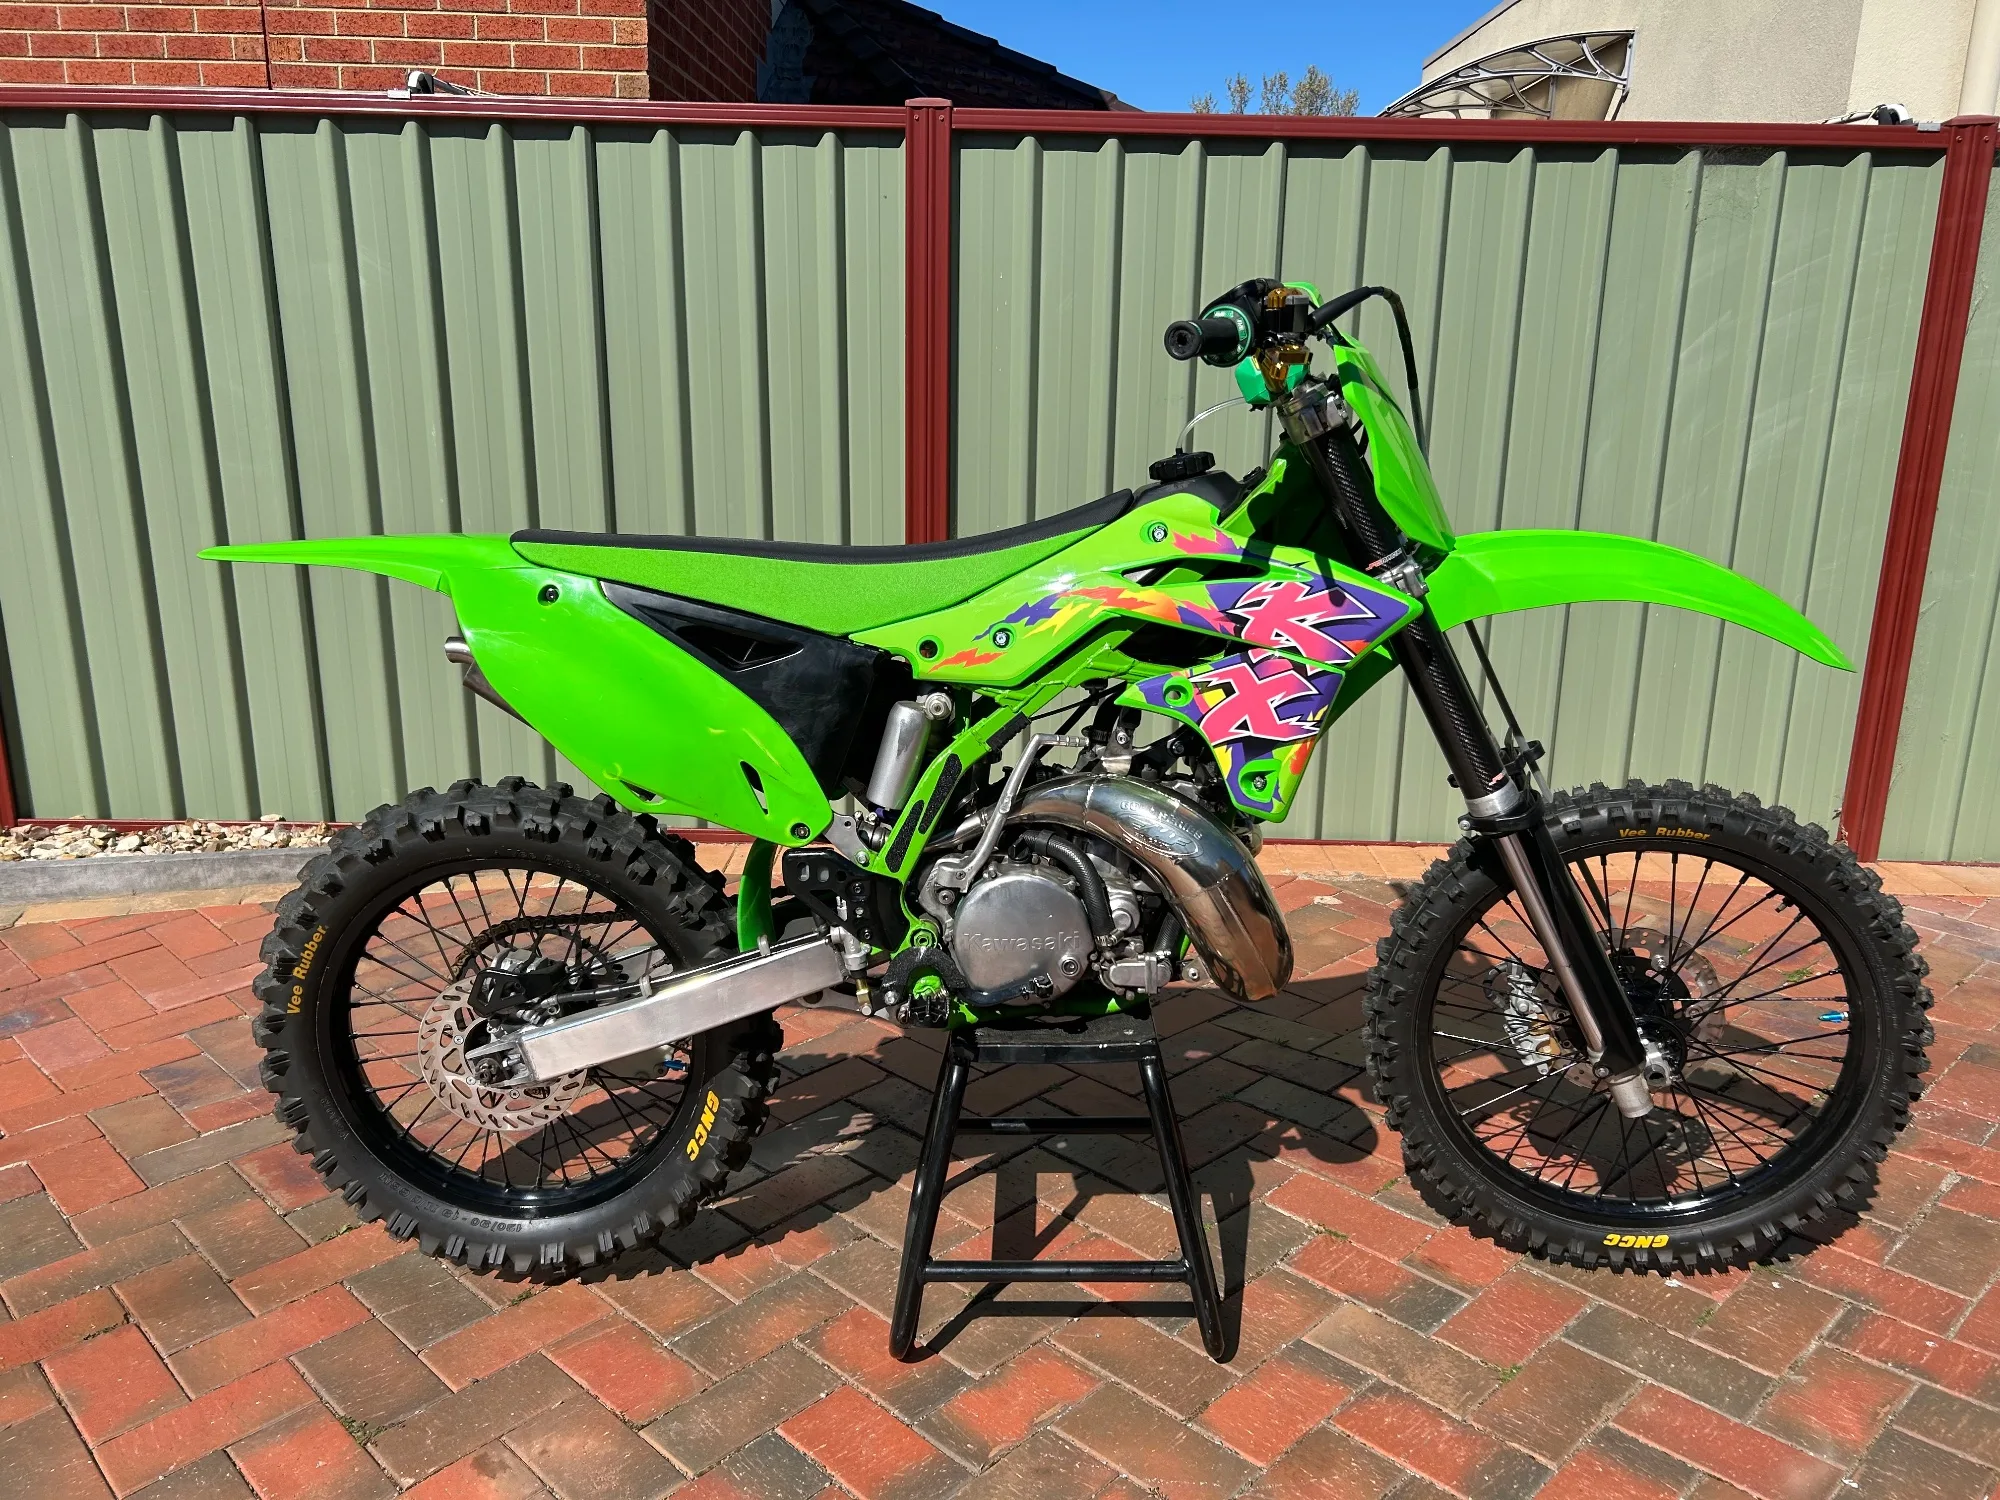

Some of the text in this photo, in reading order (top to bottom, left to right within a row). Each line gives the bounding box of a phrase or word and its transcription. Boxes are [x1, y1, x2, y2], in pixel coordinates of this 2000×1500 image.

[1619, 827, 1711, 840] Vee Rubber
[963, 930, 1080, 951] Kawasaki
[286, 925, 326, 1014] Vee Rubber
[686, 1090, 720, 1162] GNCC
[1602, 1233, 1670, 1249] GNCC
